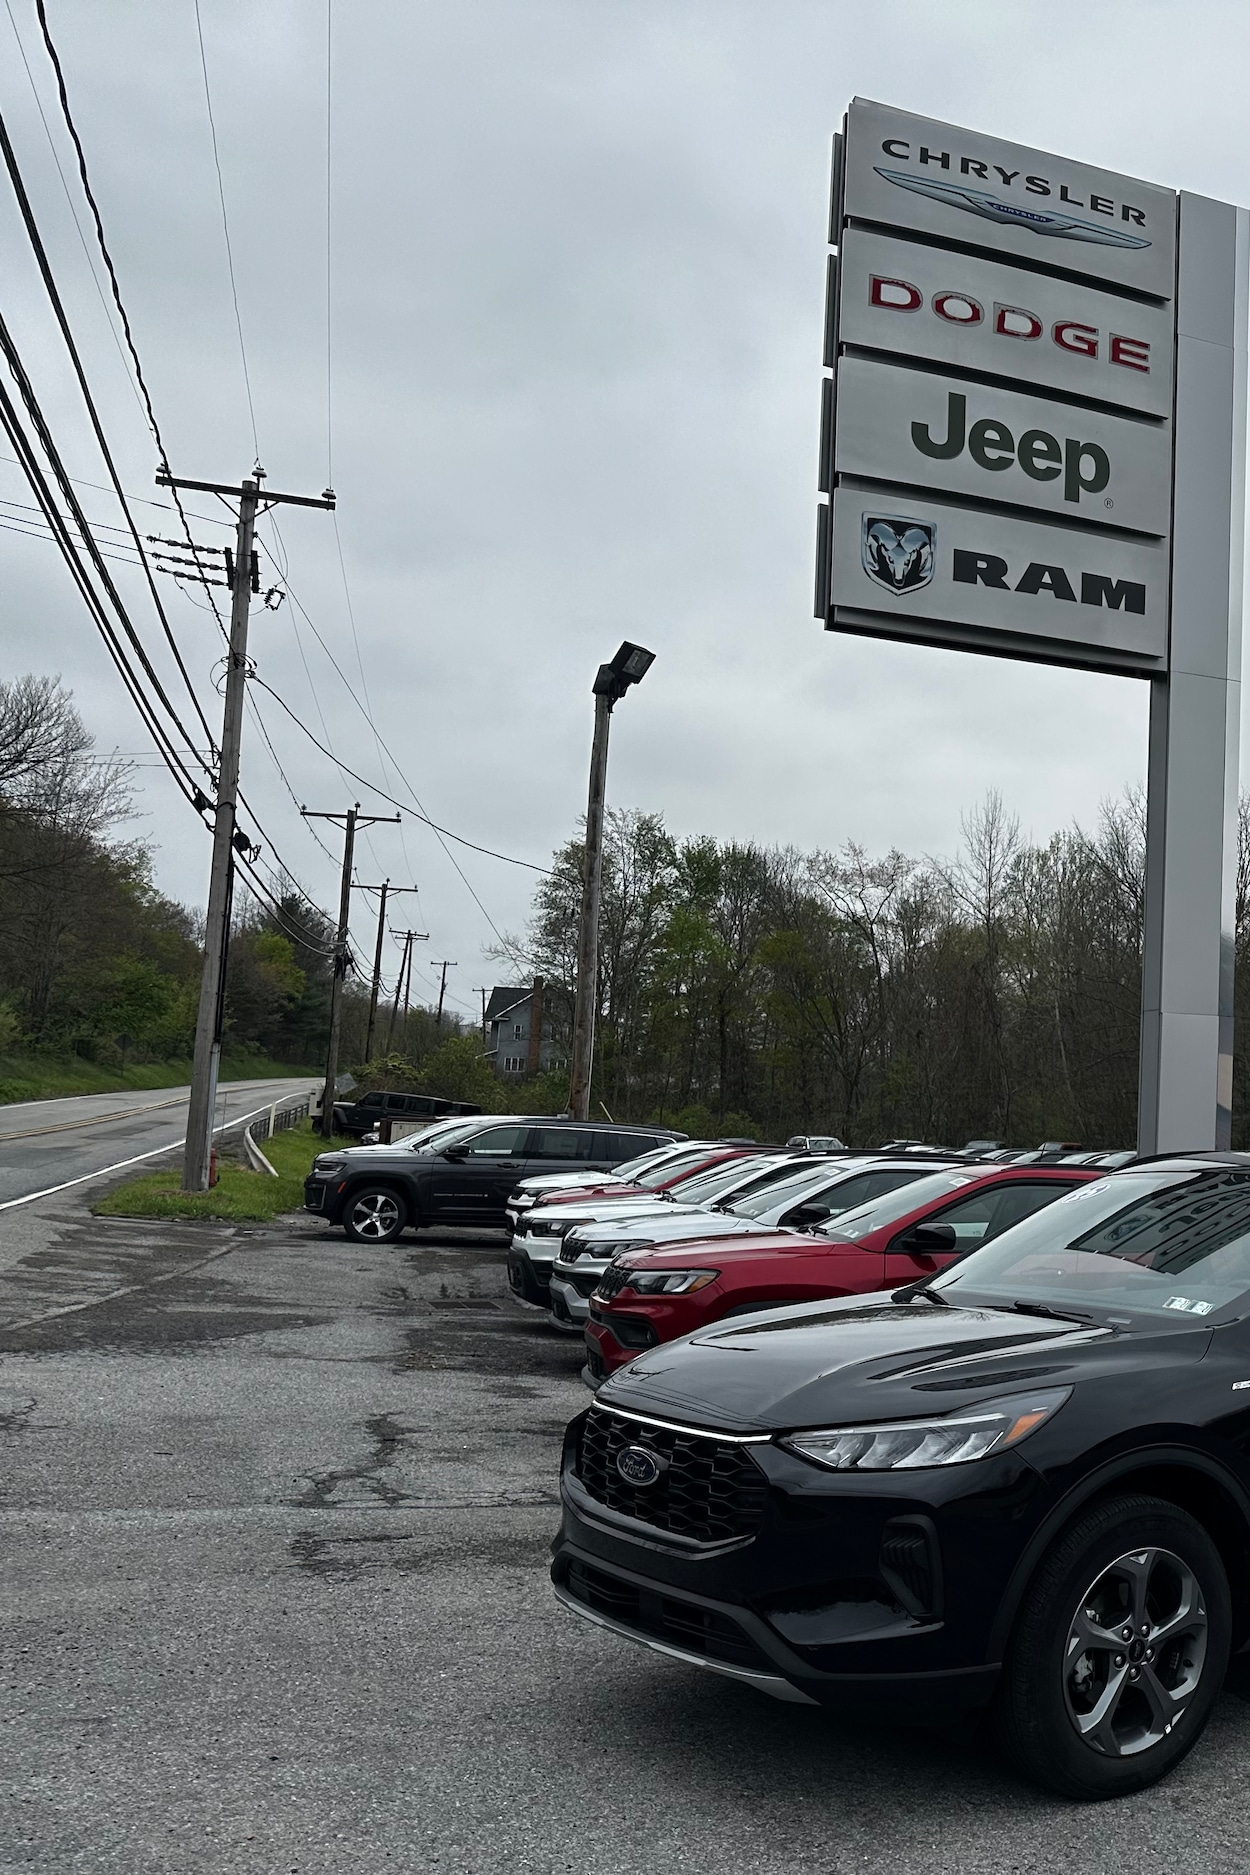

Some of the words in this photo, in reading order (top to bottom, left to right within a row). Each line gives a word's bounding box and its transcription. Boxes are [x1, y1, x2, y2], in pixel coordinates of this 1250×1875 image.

[881, 138, 1147, 228] CHRYSLER
[992, 203, 1048, 222] CHRYSLER
[869, 273, 1151, 374] DODGE
[911, 391, 1111, 503] Jeep
[953, 548, 1146, 616] RAM
[623, 1453, 648, 1478] Ford
